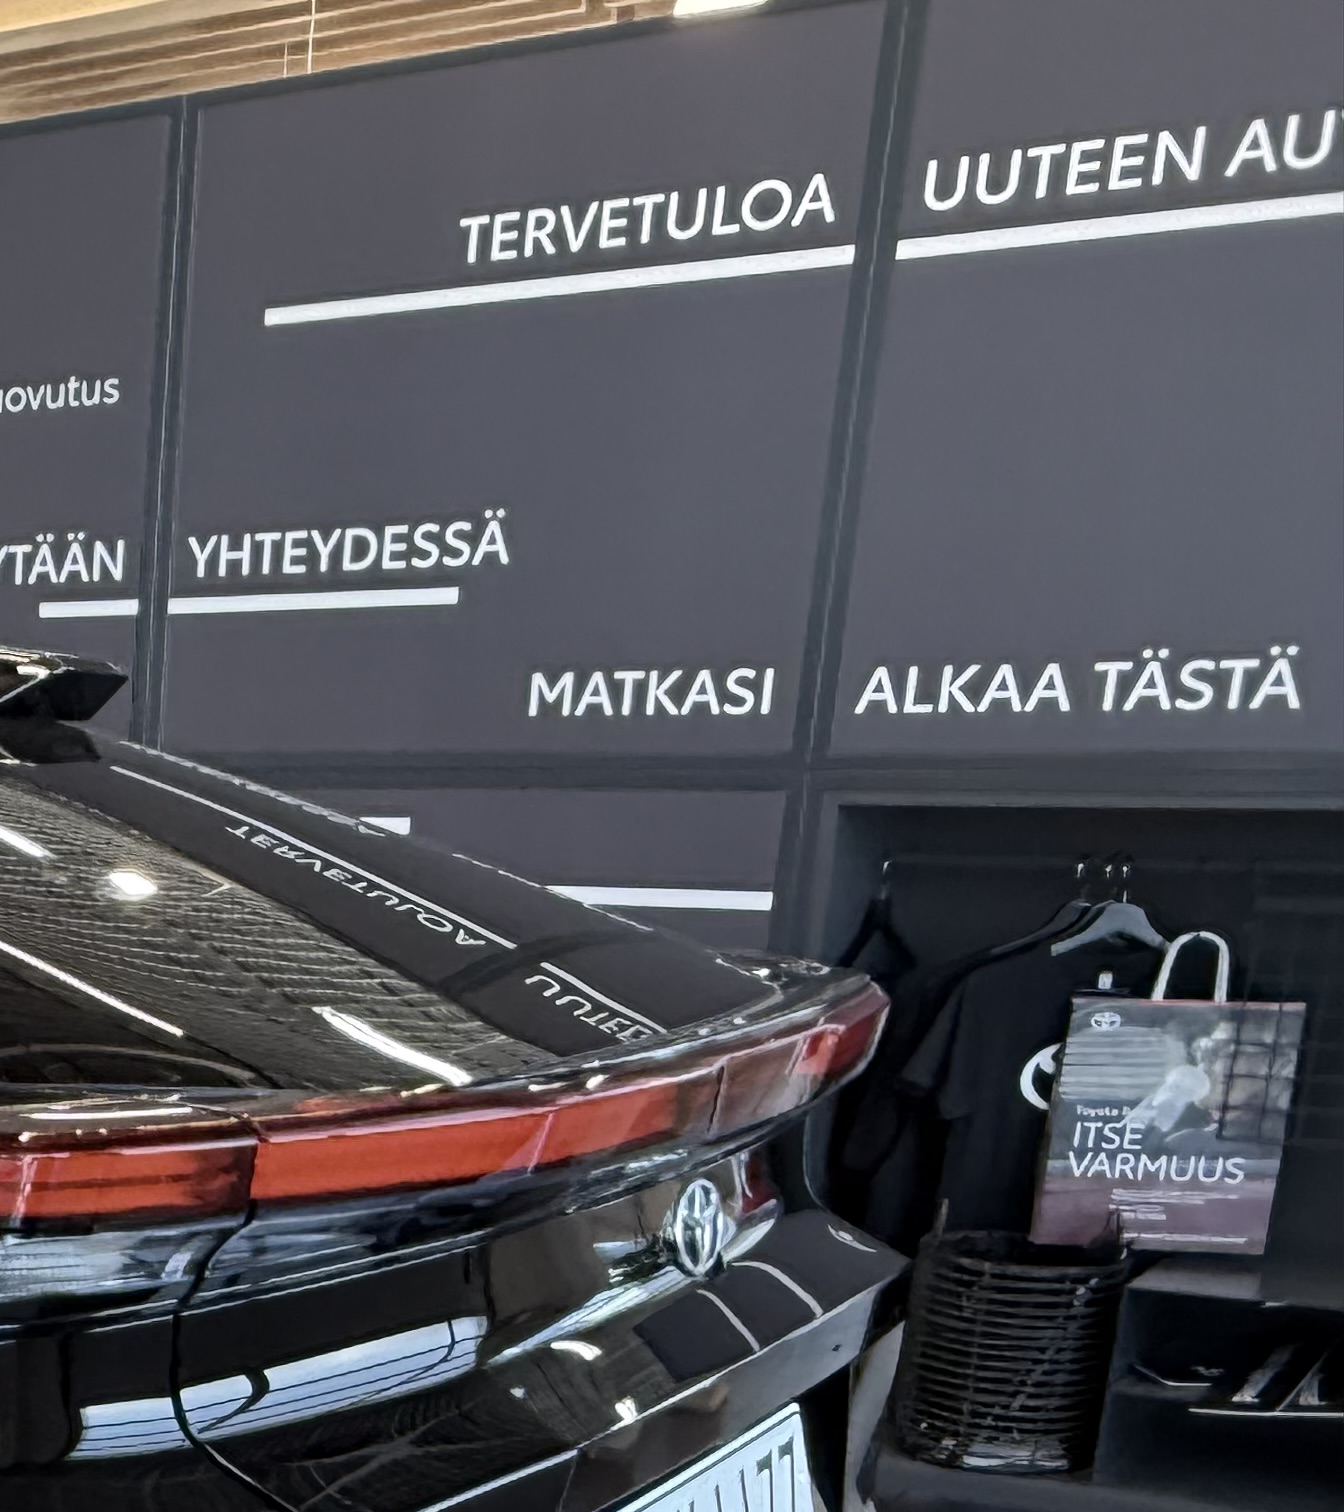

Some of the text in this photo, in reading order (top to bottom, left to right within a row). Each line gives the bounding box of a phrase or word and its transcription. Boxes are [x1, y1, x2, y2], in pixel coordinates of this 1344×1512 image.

[459, 109, 1344, 264] TERVETULOA UUTEEN AU
[187, 507, 510, 578] YHTEYDESSÄ
[528, 645, 1301, 717] MATKASI ALKAA TÄSTÄ
[1068, 1151, 1245, 1184] VARMUUS
[1073, 1121, 1145, 1149] ITSE
